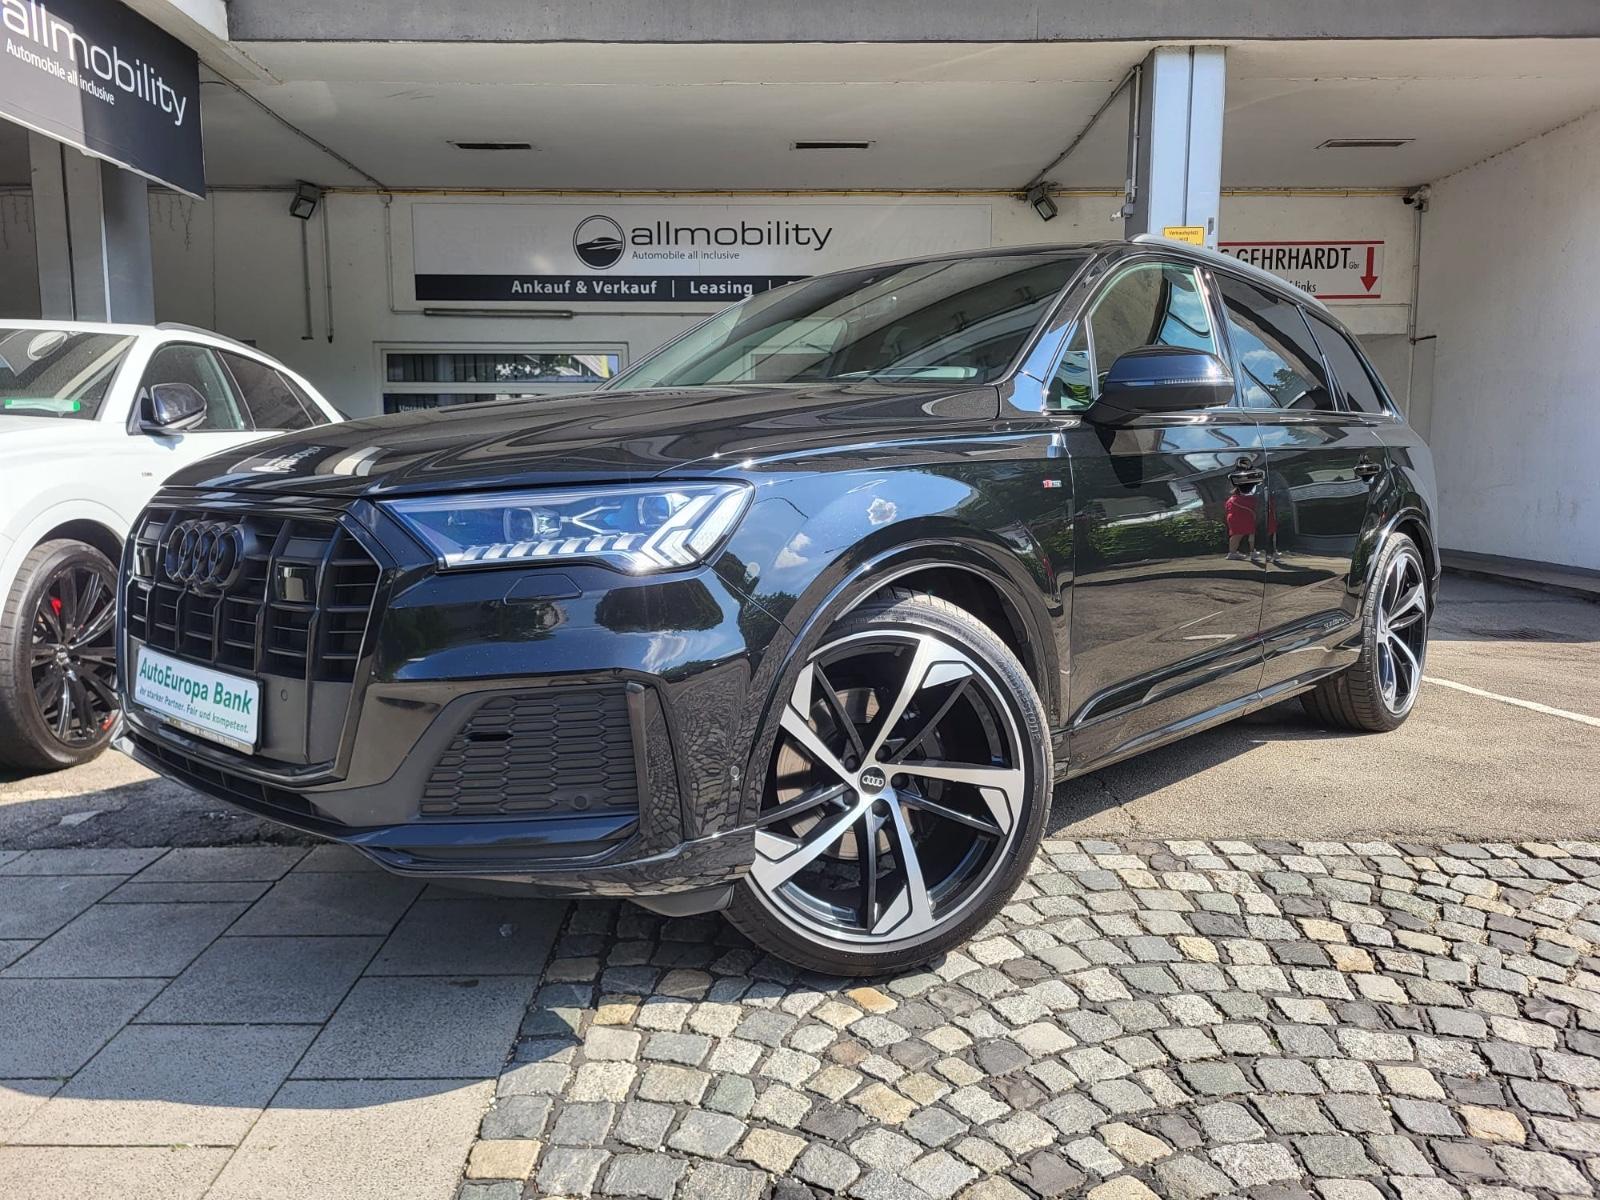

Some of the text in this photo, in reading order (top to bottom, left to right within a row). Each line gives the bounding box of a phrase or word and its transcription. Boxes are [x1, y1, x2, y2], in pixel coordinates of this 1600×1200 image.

[1, 0, 187, 126] allmobility
[6, 38, 115, 106] Automobile all inclusive
[630, 220, 833, 250] allmobility
[631, 250, 686, 261] Automobile
[687, 250, 699, 261] all
[511, 279, 753, 297] Ankauf & Verkauf Leasing
[140, 657, 253, 715] AutoEuropa Bank
[187, 702, 199, 716] Fair
[199, 710, 213, 721] und
[213, 712, 249, 733] kompetent.
